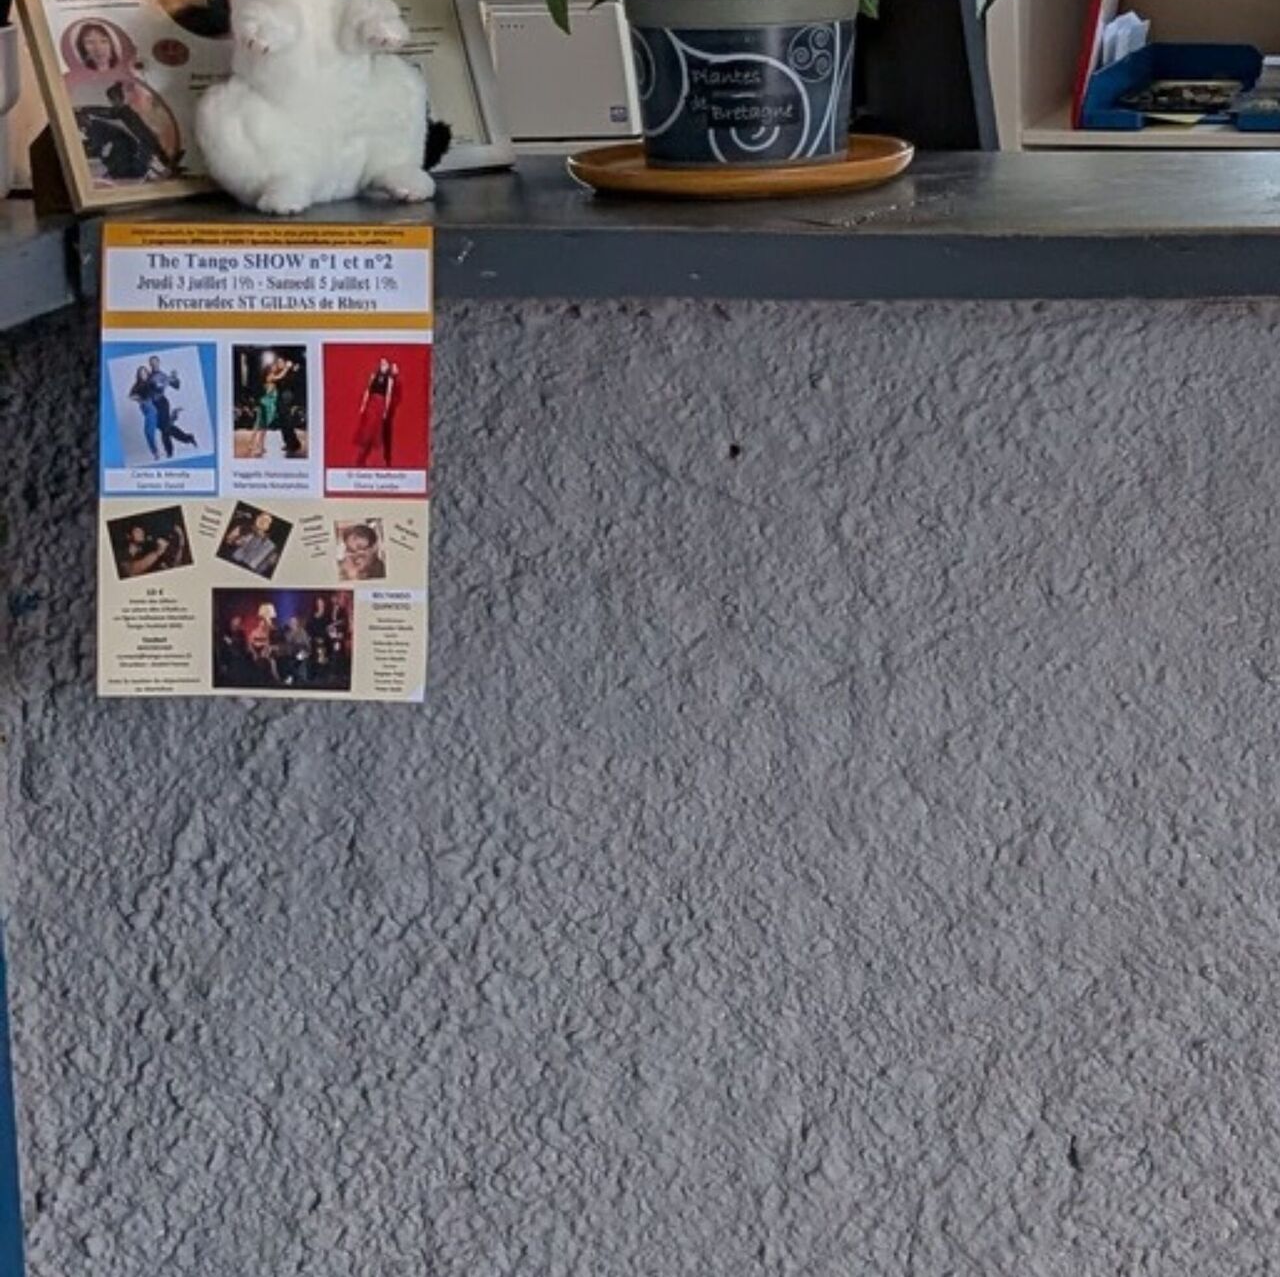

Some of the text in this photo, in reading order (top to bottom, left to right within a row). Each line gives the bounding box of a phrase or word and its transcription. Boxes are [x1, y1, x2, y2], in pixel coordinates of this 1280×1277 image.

[691, 68, 762, 86] Plantes
[711, 103, 794, 123] Bretagne
[147, 253, 393, 273] The Tango SHOW n°1 et n°2
[136, 275, 173, 290] Jeudi
[176, 276, 185, 290] 3
[187, 275, 227, 292] juillet
[232, 275, 254, 290] 19h
[266, 275, 315, 290] Samedi
[319, 275, 328, 290] 5
[330, 275, 371, 292] juillet
[157, 294, 378, 311] Kercaradec ST GILDAS de Rhuys
